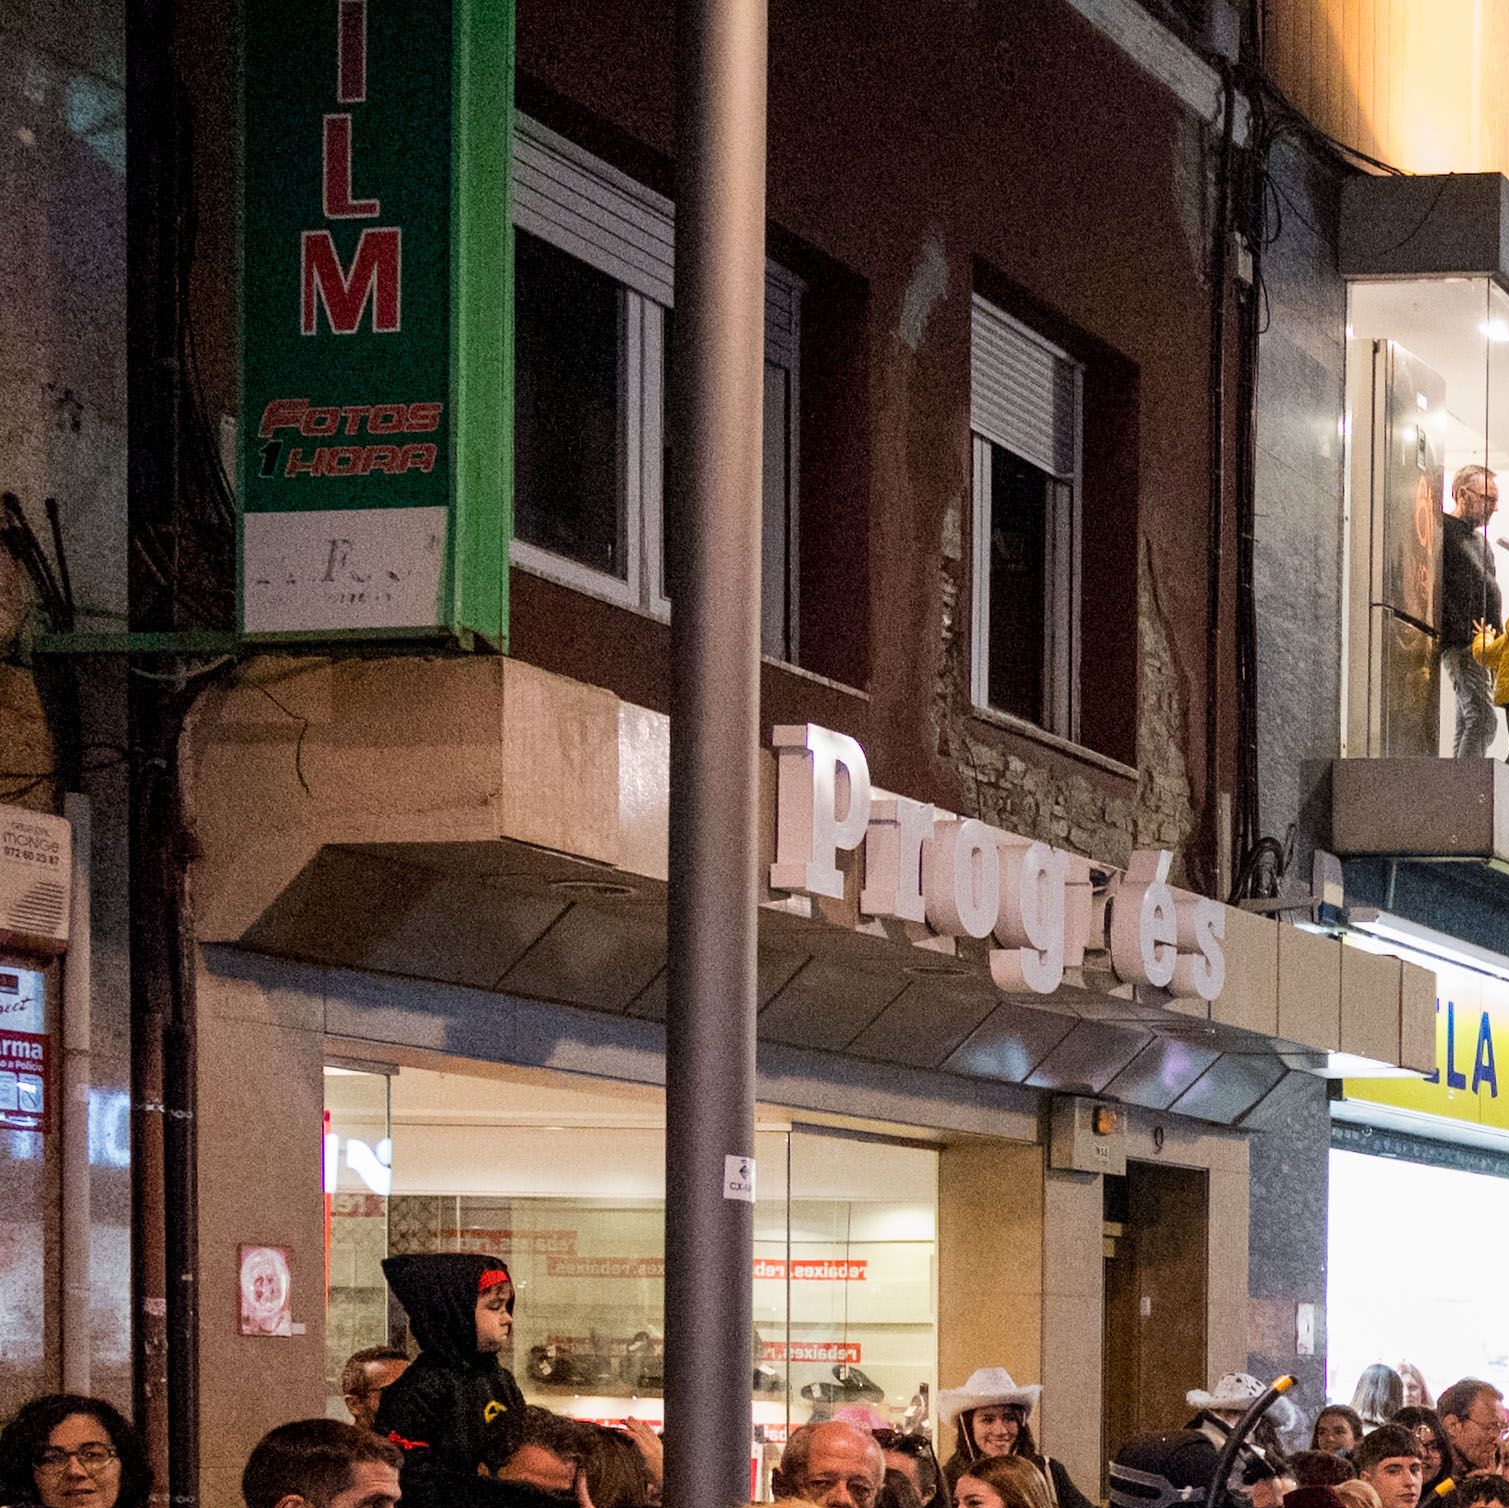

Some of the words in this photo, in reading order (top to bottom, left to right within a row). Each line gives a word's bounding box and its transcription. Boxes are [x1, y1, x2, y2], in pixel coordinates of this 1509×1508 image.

[258, 399, 443, 438] FOTOS
[258, 439, 284, 479] 1
[285, 443, 438, 478] HORA
[0, 1039, 44, 1061] rma
[1423, 998, 1498, 1098] LA
